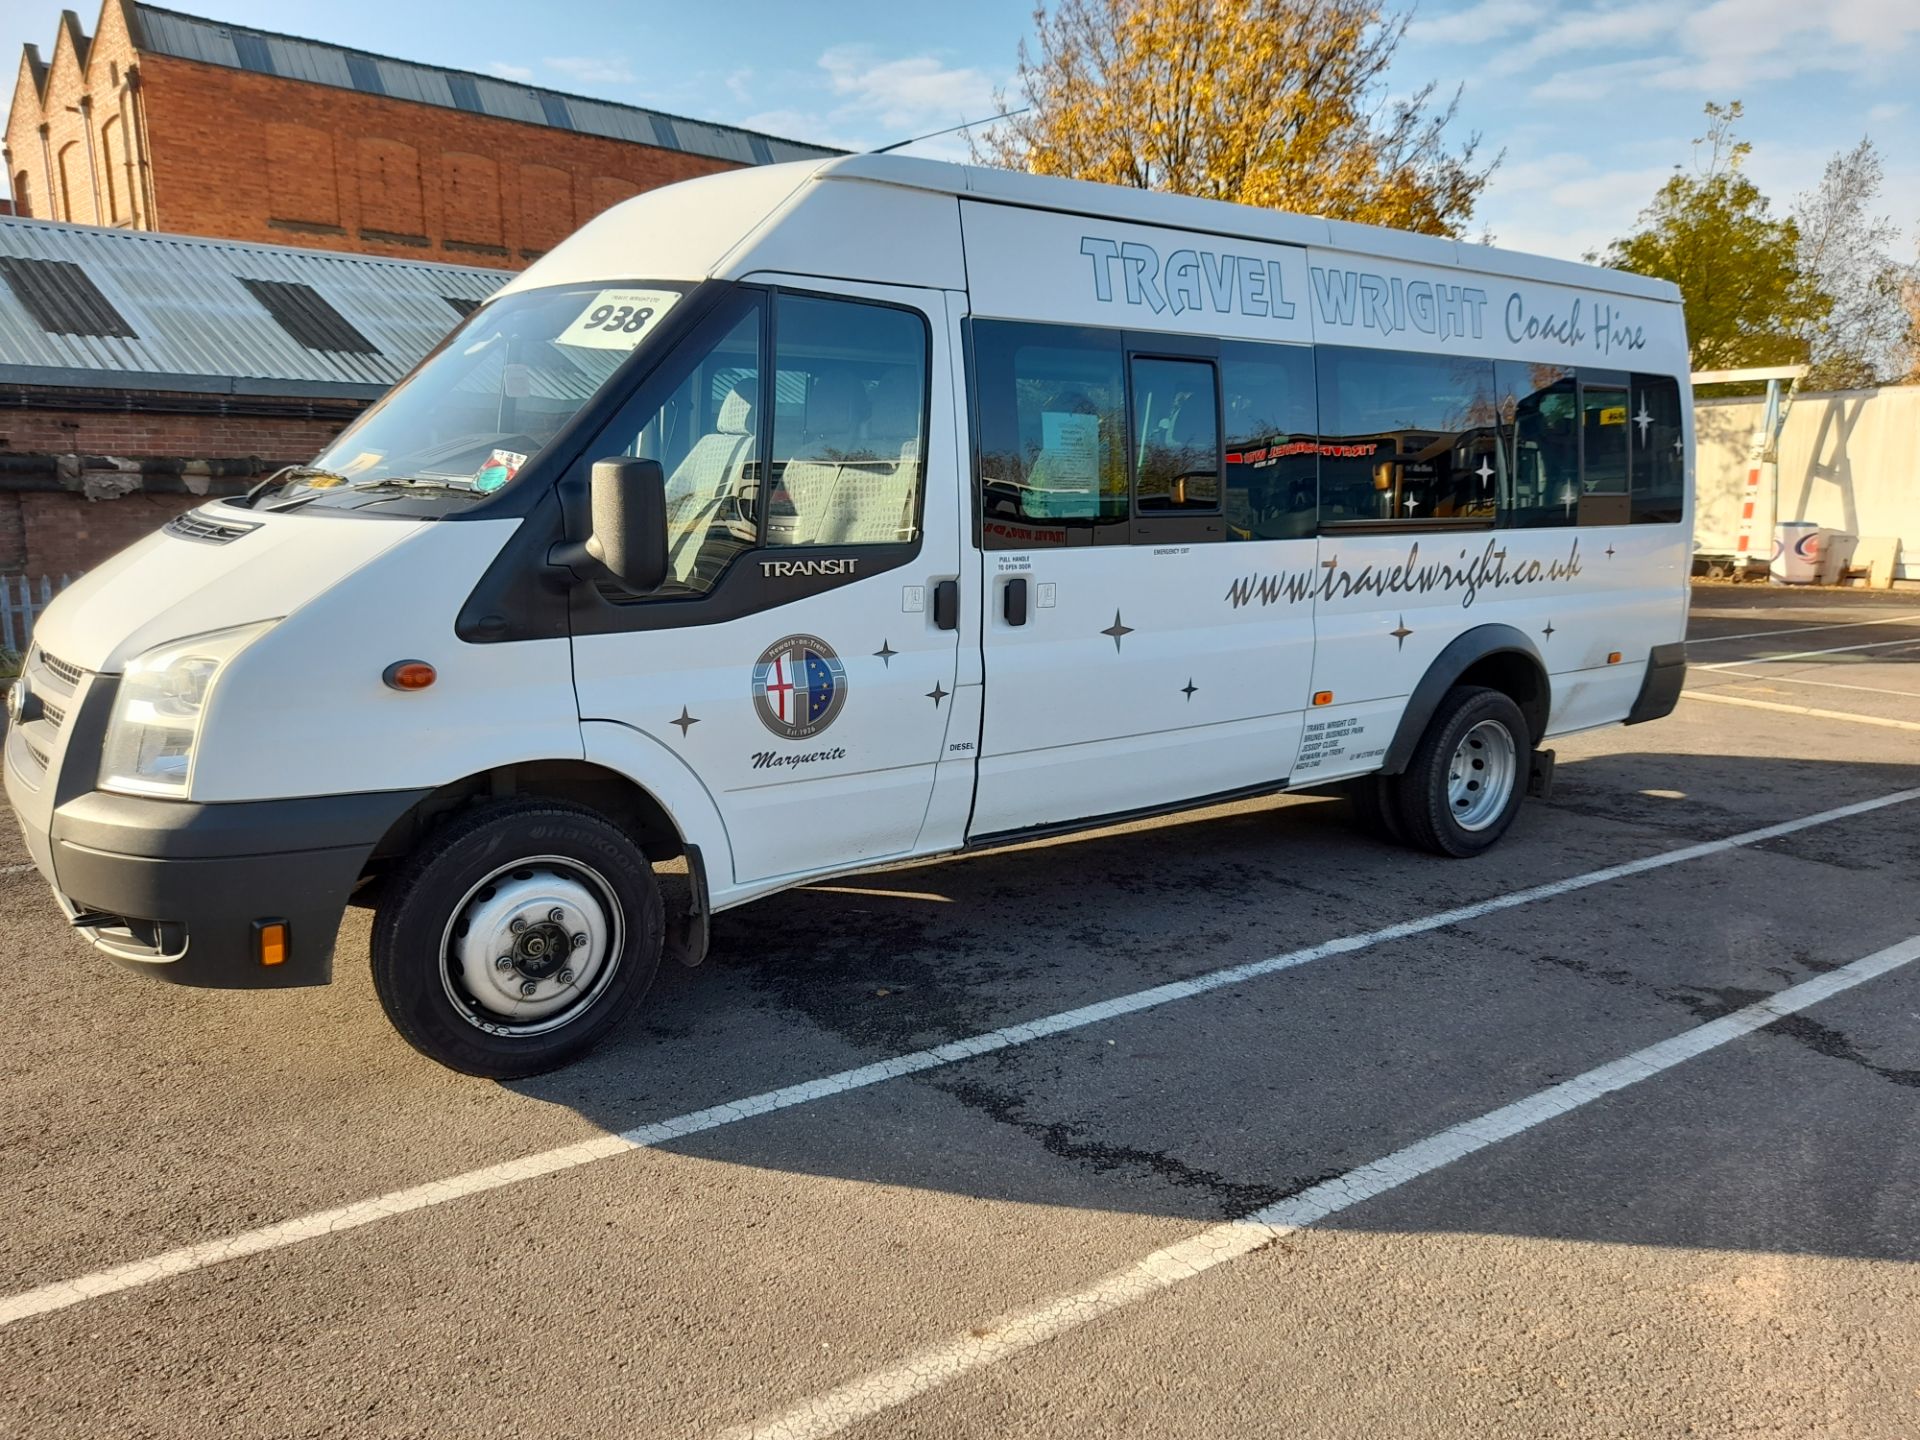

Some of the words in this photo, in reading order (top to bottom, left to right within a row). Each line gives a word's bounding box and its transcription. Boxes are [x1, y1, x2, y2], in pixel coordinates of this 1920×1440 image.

[1080, 236, 1296, 320] TRAVEL
[1310, 267, 1488, 342] WRIGHT
[1504, 292, 1586, 347] Coach
[1593, 302, 1647, 356] Hire
[583, 304, 655, 333] 938
[759, 558, 859, 578] TRANSIT
[1224, 536, 1582, 609] www.travelwright.co.uk
[1306, 722, 1325, 732] TRAVEL
[1327, 719, 1347, 729] WRIGHT
[751, 747, 846, 770] Marguerite
[949, 742, 975, 752] DIESEL
